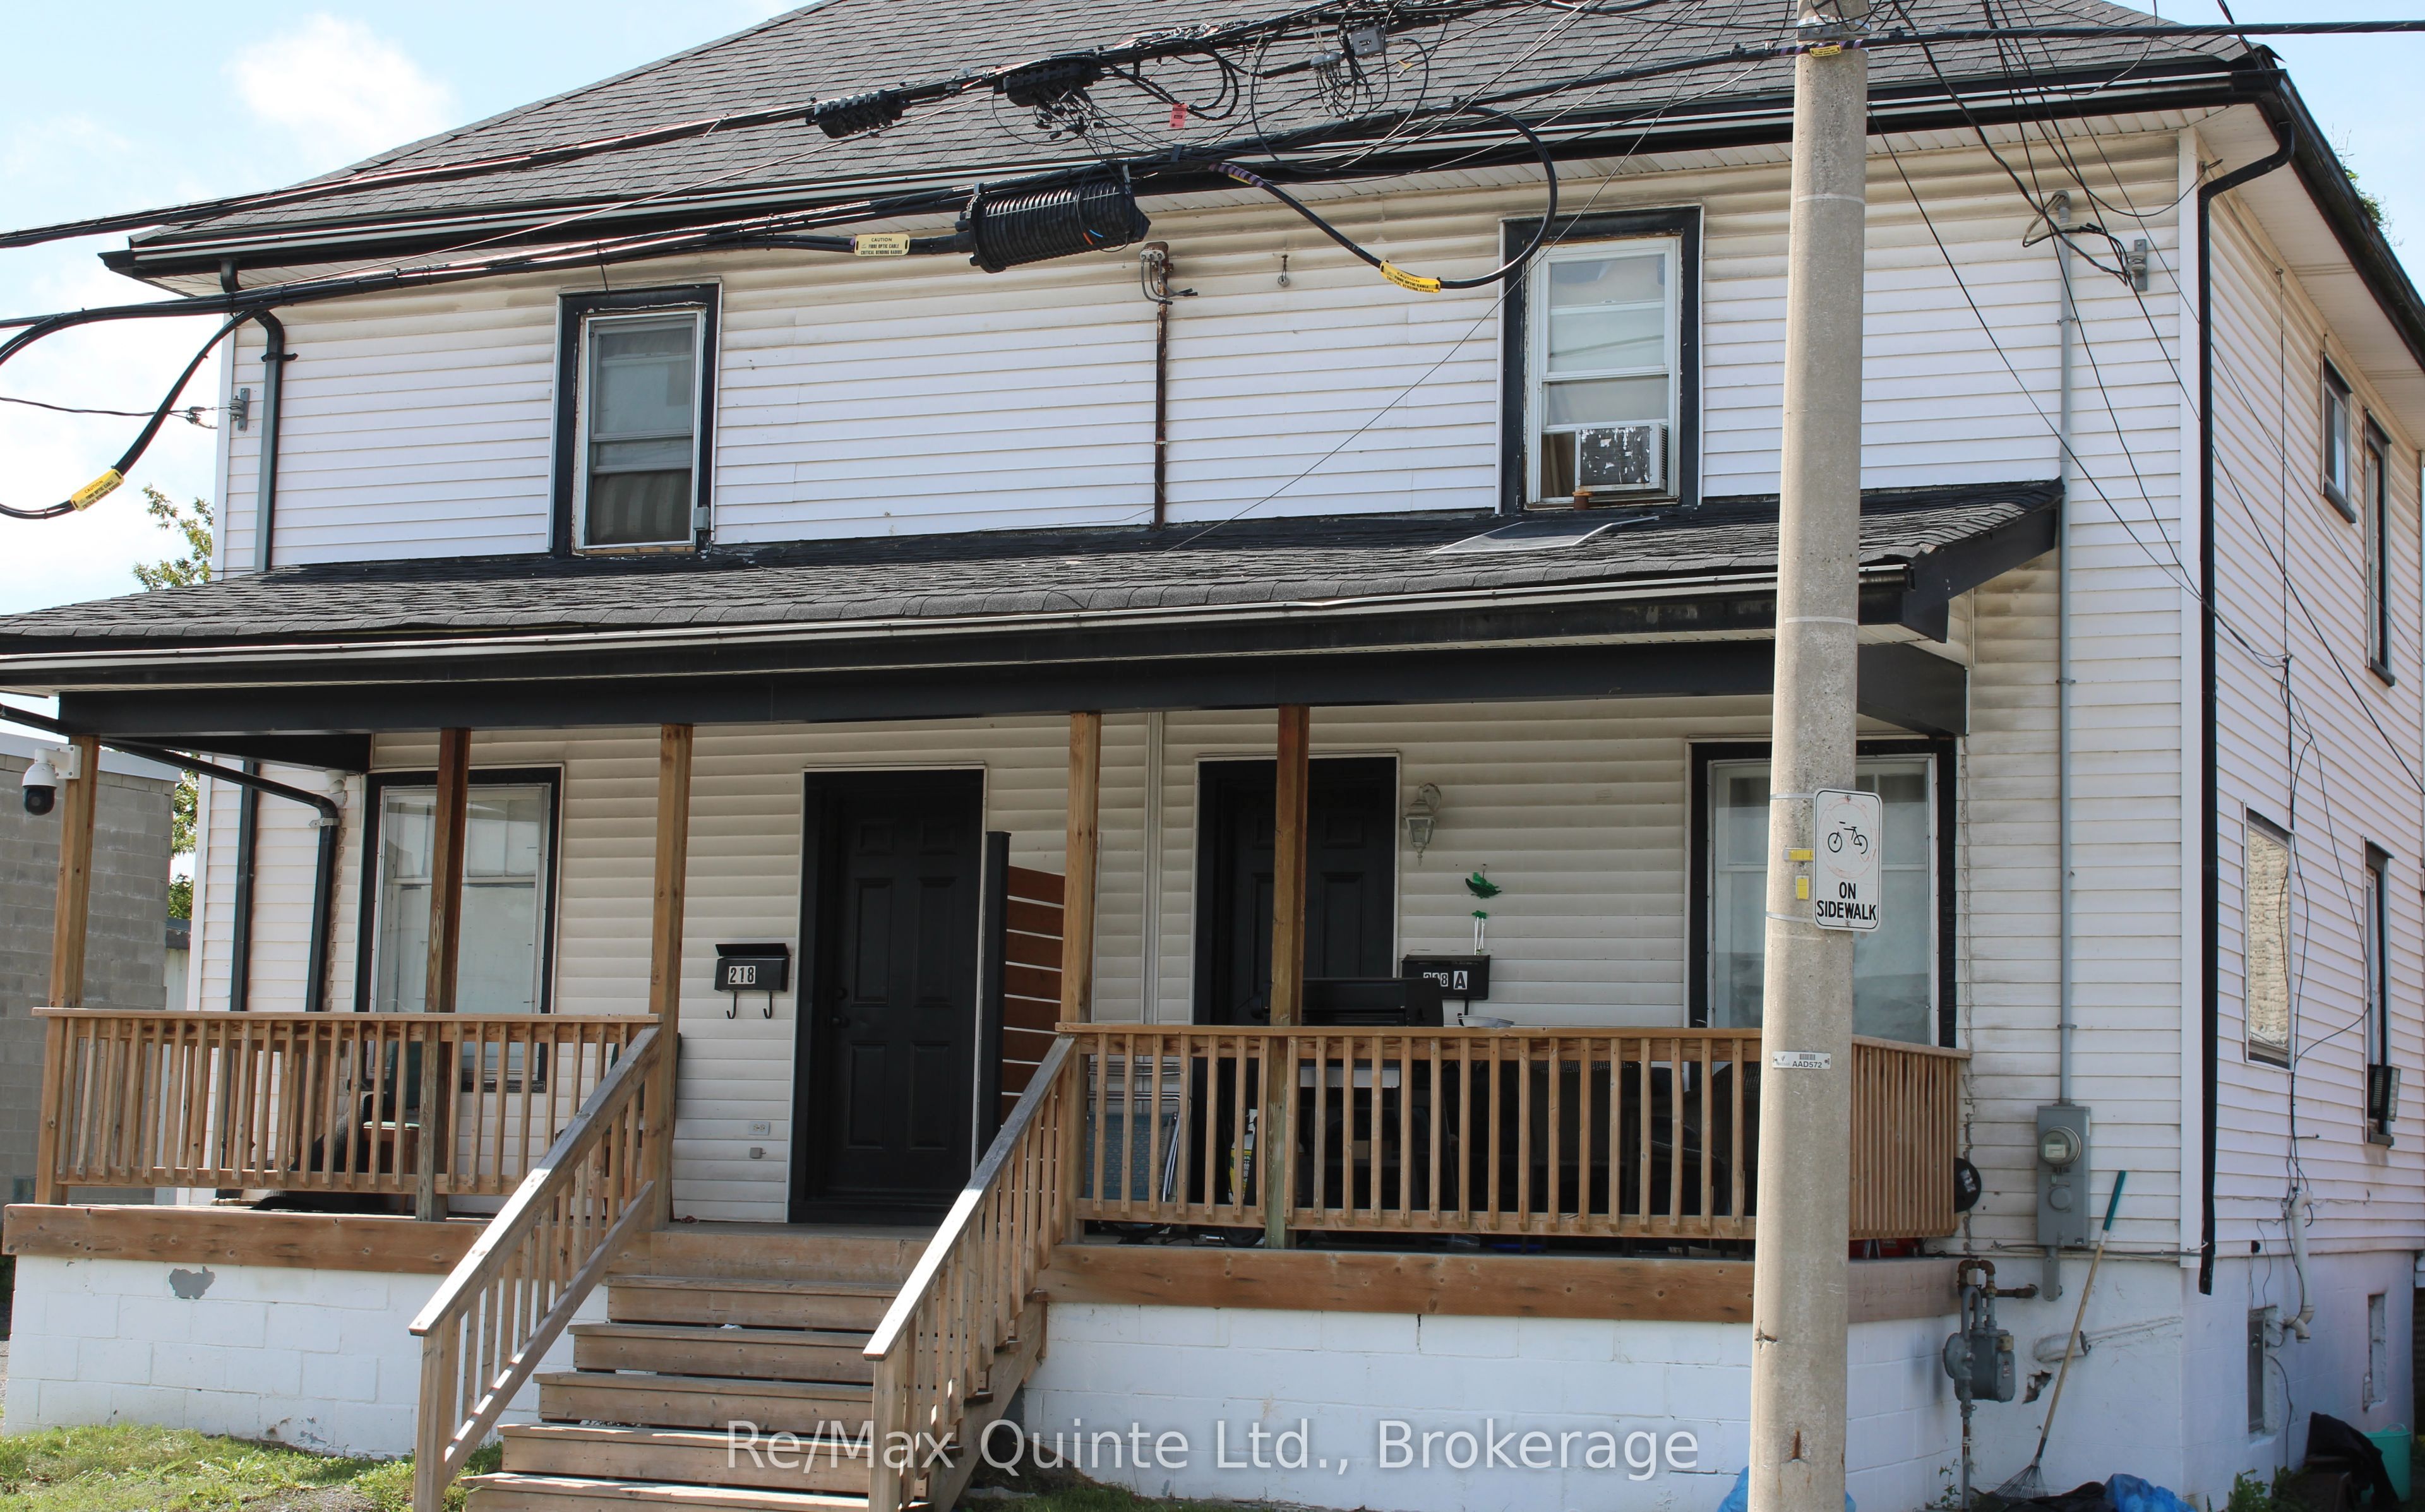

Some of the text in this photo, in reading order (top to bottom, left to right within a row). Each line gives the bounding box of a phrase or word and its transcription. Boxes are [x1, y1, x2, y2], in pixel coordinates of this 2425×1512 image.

[1397, 272, 1420, 283] CAUTION
[85, 480, 104, 494] CAUTION
[1839, 881, 1856, 900] ON
[1816, 900, 1877, 920] SIDEWALK
[729, 967, 755, 983] 218
[1454, 971, 1466, 989] A
